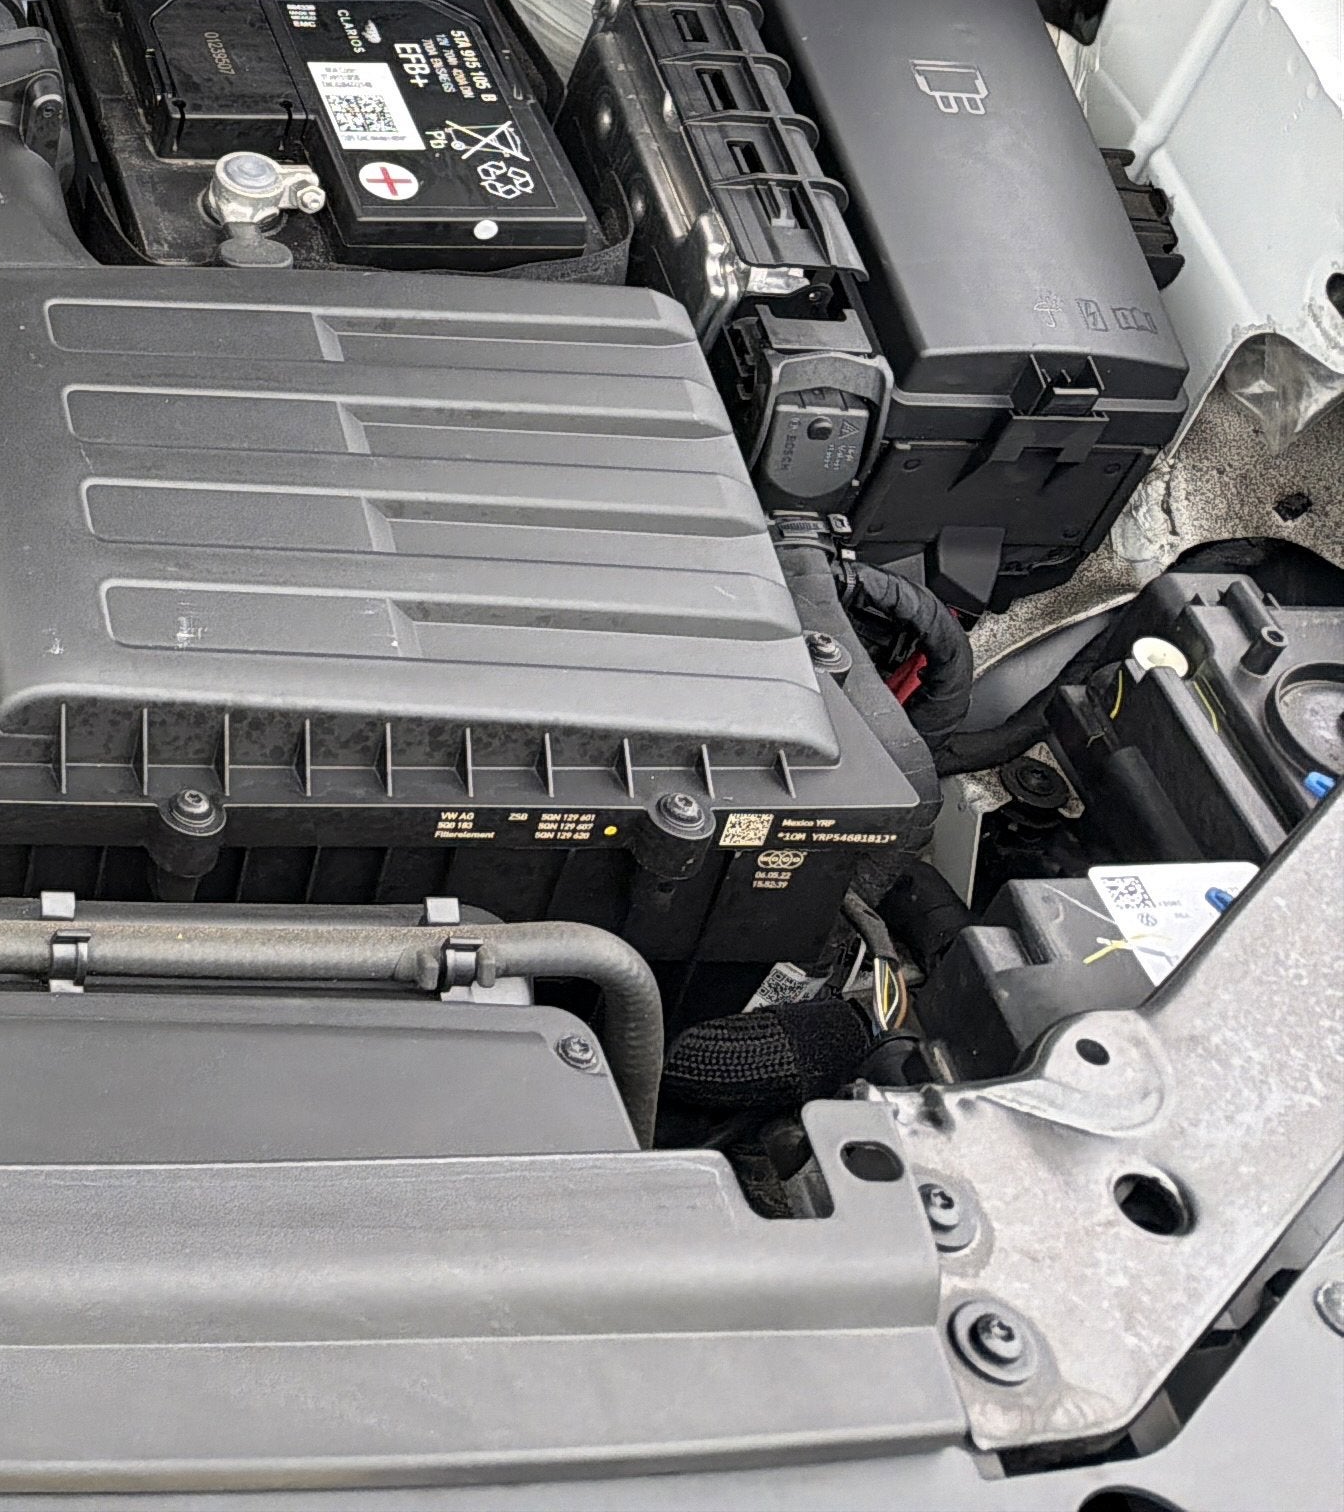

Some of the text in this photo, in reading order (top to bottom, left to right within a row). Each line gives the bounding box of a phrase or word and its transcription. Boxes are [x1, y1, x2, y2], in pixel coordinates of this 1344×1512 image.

[337, 9, 366, 54] CLARIOS
[204, 32, 235, 75] 01239507
[393, 43, 431, 88] EFB+
[451, 29, 498, 102] 5TA 915 105 B
[425, 130, 448, 149] Pb
[440, 811, 458, 820] VW
[459, 811, 475, 820] AG
[782, 819, 836, 828] Mexico YRP
[434, 830, 496, 839] Filterelement
